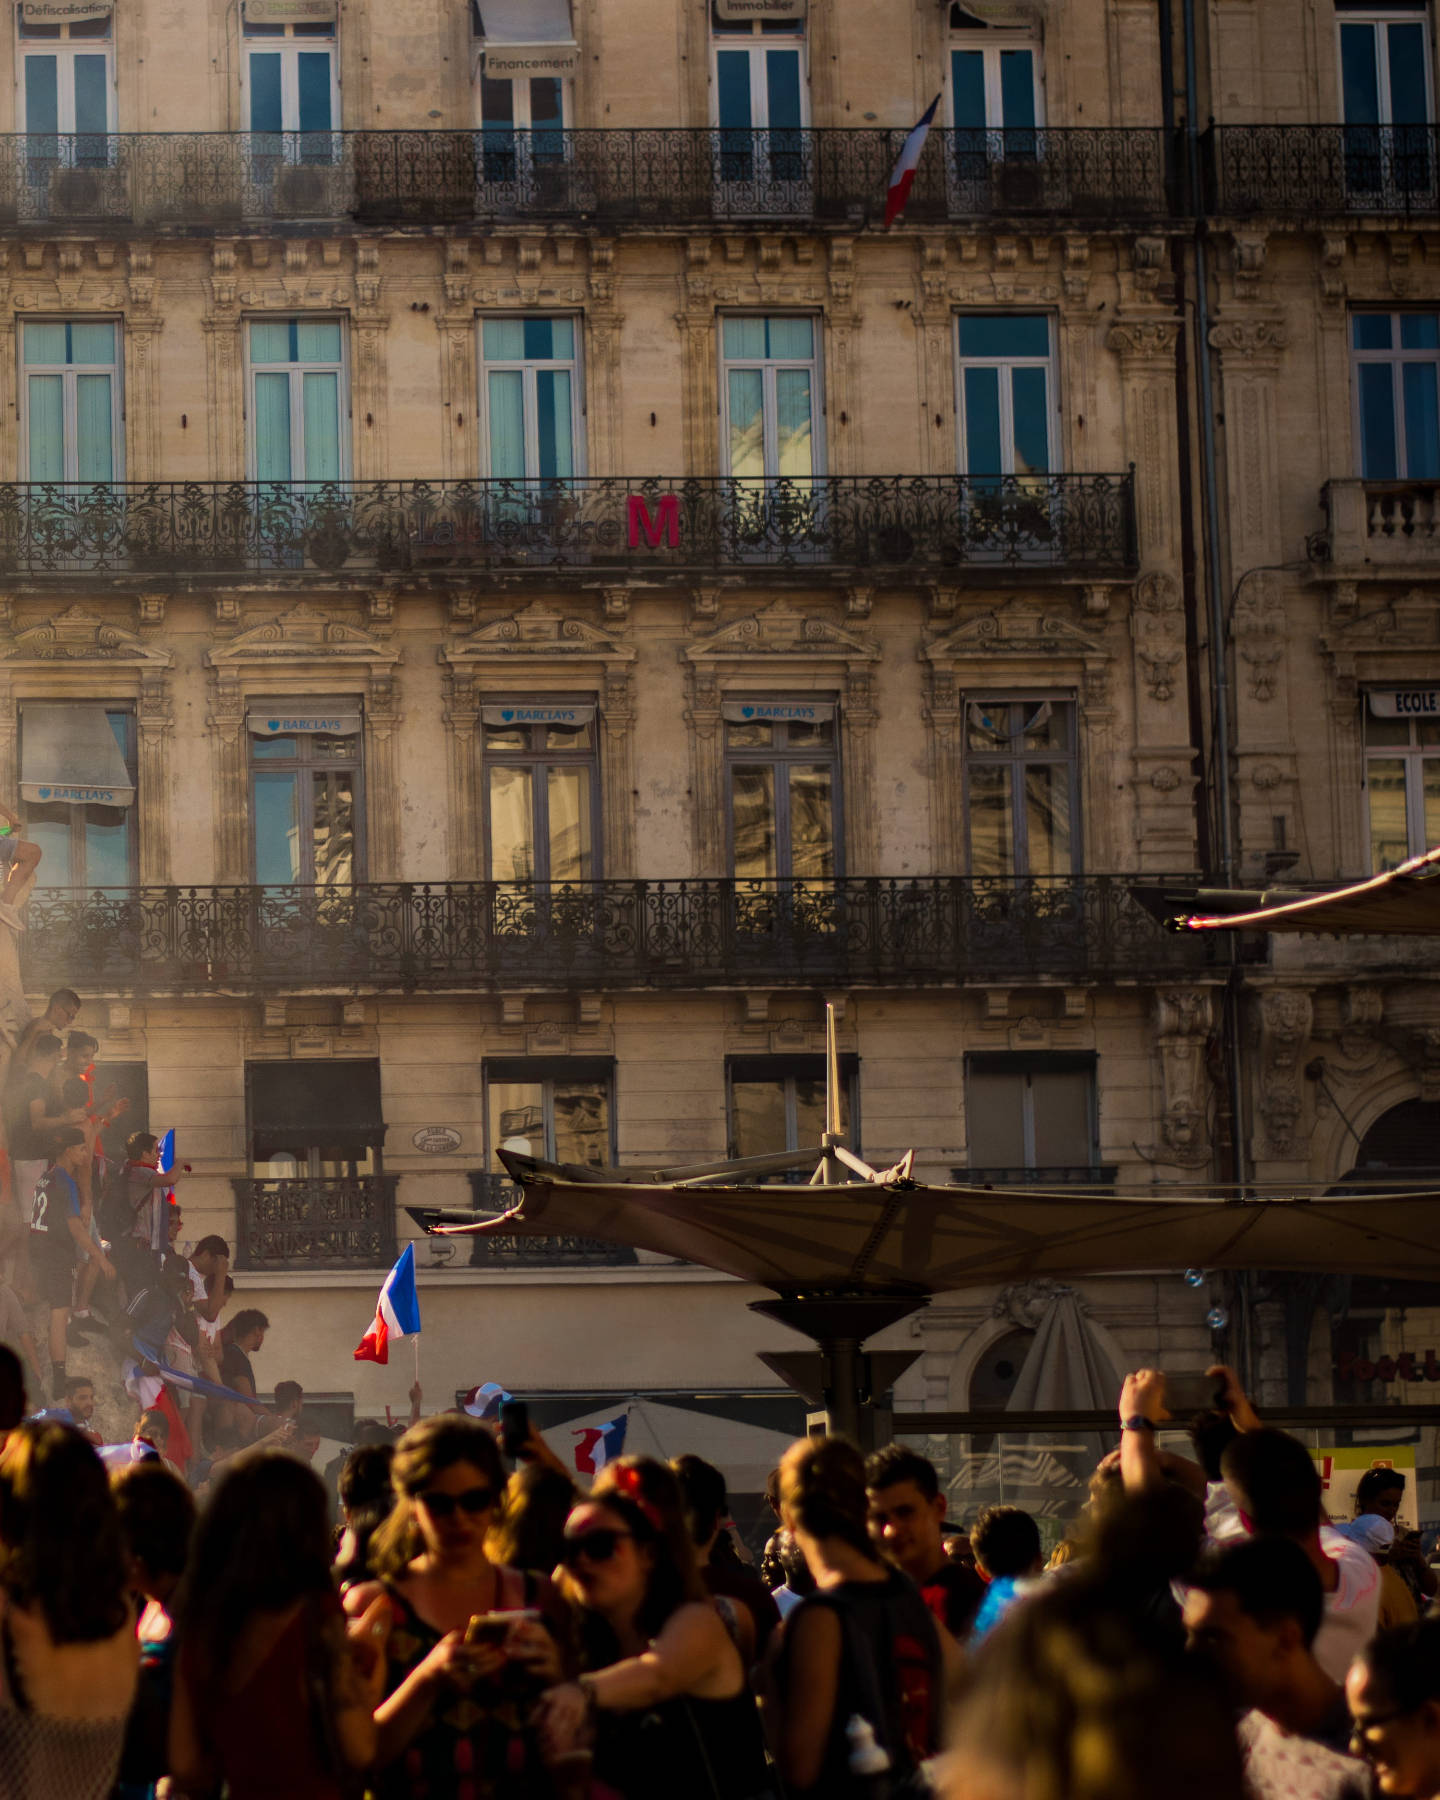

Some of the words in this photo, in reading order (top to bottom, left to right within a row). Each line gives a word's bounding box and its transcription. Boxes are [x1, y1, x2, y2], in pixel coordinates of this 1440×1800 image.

[25, 2, 111, 16] Défiscalisation
[727, 0, 794, 11] Immobilier
[489, 57, 574, 70] Financement
[627, 495, 680, 548] M
[1396, 692, 1437, 713] ECOLE
[516, 709, 576, 721] BARCLAYS
[757, 706, 815, 718] BARCLAYS
[283, 719, 341, 730] BARCLAYS
[54, 787, 113, 801] BARCLAYS
